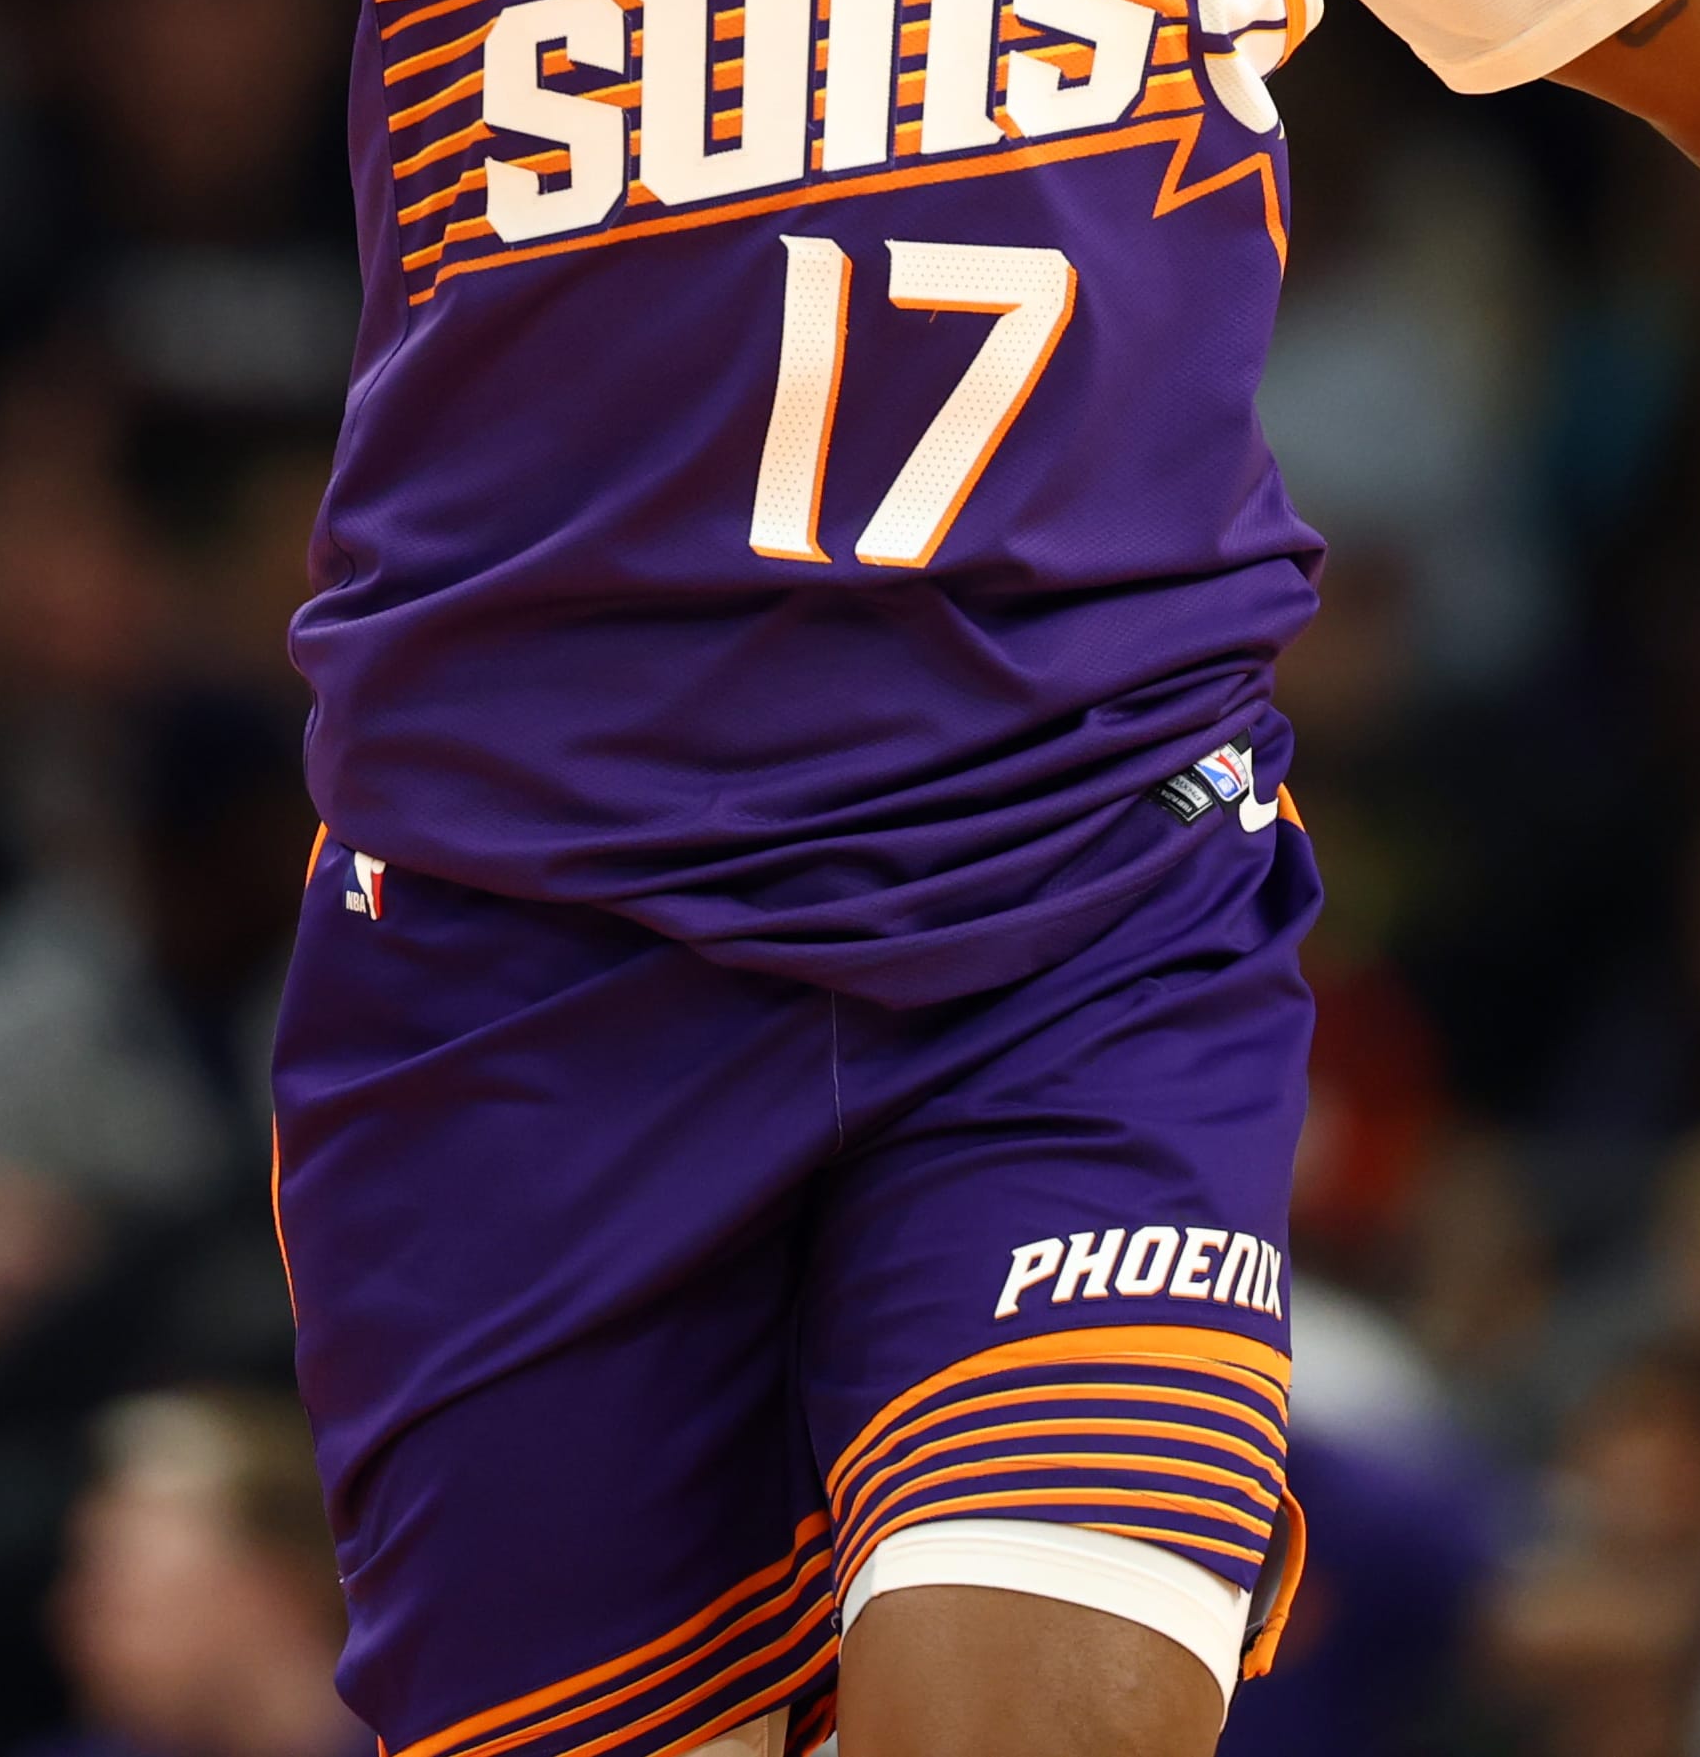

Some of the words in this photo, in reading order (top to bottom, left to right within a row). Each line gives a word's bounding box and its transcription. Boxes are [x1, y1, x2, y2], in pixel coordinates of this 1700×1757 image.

[749, 234, 1078, 569] 17
[345, 890, 367, 914] NBA
[994, 1225, 1283, 1321] PHOENIX
